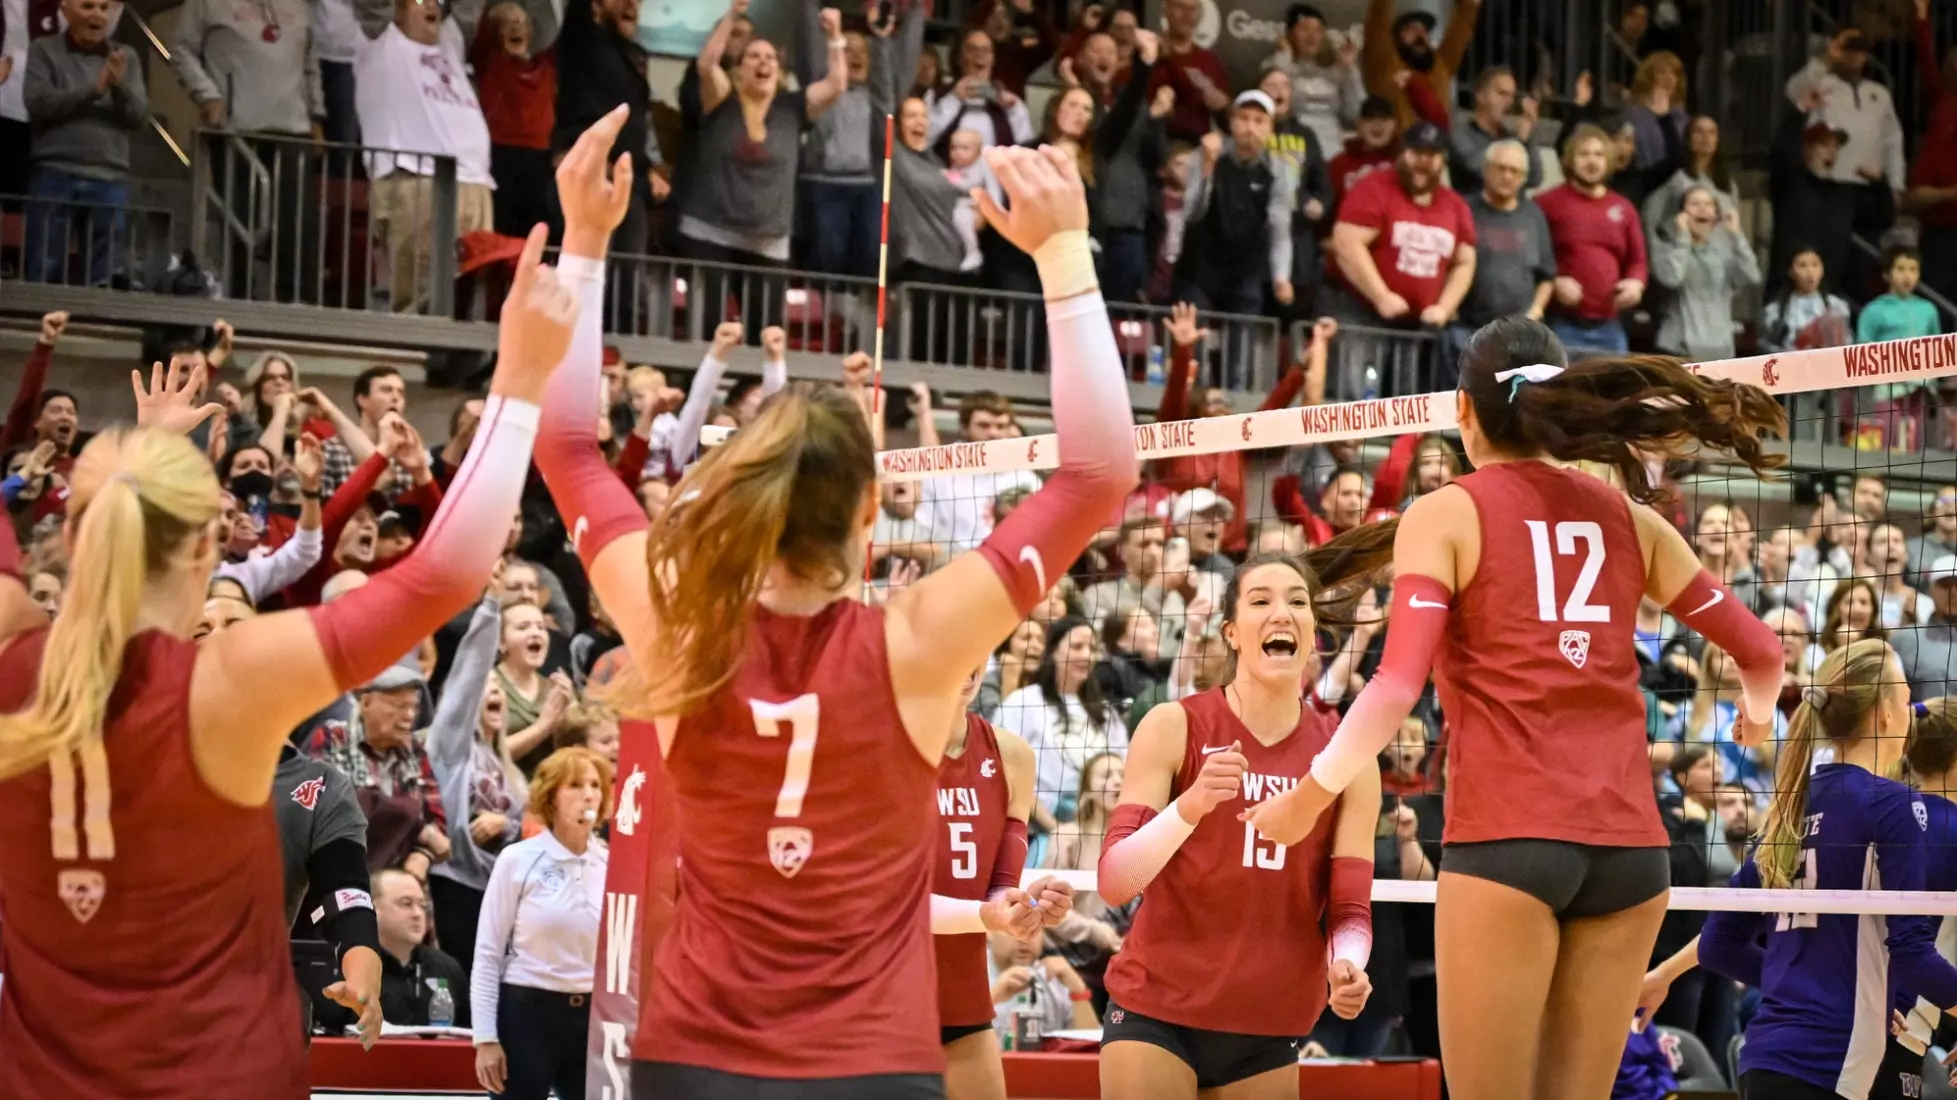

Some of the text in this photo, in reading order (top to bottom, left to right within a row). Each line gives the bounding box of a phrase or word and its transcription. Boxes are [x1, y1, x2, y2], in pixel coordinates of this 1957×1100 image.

[1843, 335, 1956, 378] WASHINGTON
[1161, 421, 1196, 449] STATE
[1301, 396, 1430, 434] WASHINGTON STATE
[882, 443, 987, 473] WASHINGTON STATE
[1524, 519, 1610, 622] 12
[748, 692, 820, 818] 7
[49, 737, 116, 860] 11
[936, 787, 980, 816] WSU
[947, 822, 978, 879] 5
